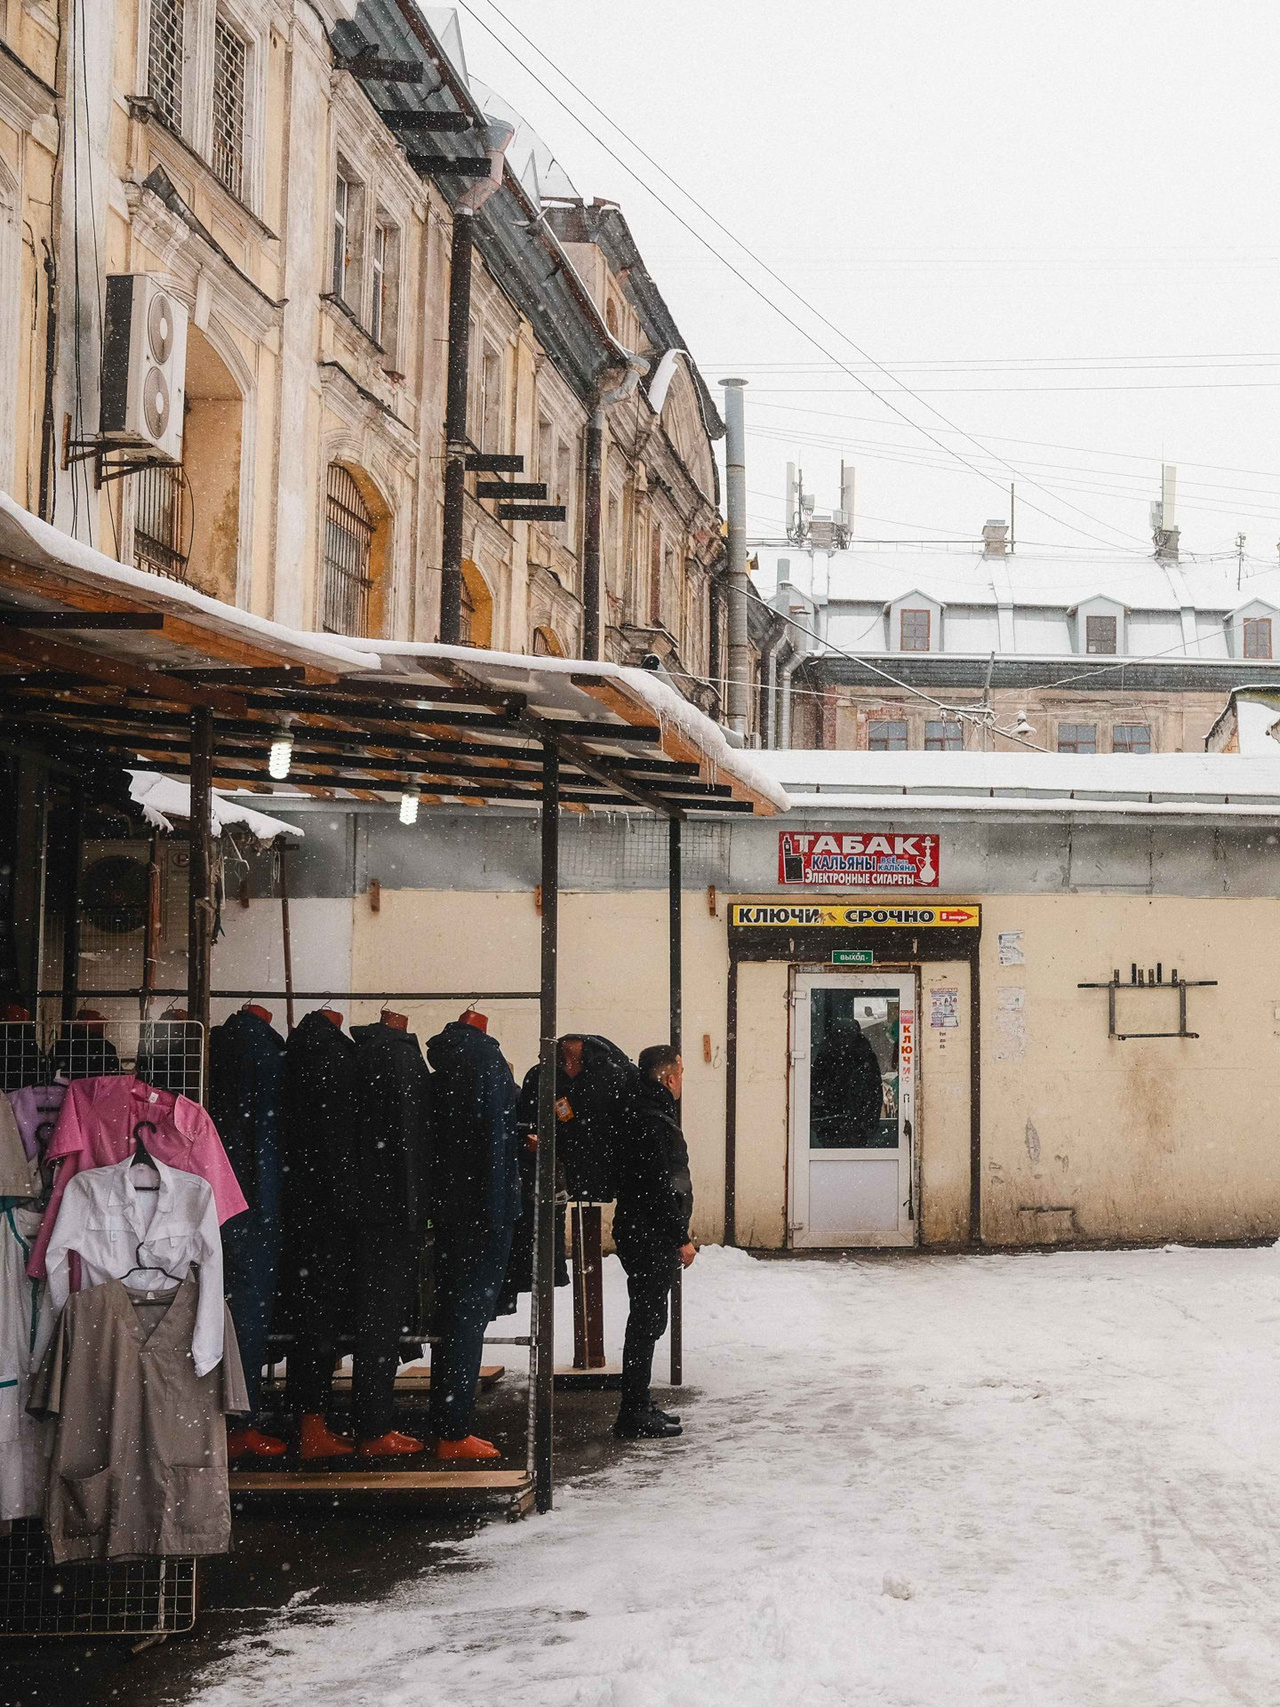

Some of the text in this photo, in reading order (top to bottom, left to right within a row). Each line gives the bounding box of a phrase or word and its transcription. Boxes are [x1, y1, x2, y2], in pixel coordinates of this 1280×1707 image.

[793, 834, 920, 855] ТАБАК
[812, 855, 876, 871] КАЛЬЯНЫ
[878, 864, 917, 872] КАЛЬЯНА
[805, 869, 915, 885] ЭЛЕКТРОННЫЕ СИГАРЕТЫ
[739, 908, 820, 924] КЛЮЧИ
[843, 908, 935, 925] СРОЧНО
[901, 1025, 913, 1075] КЛЮЧИ
